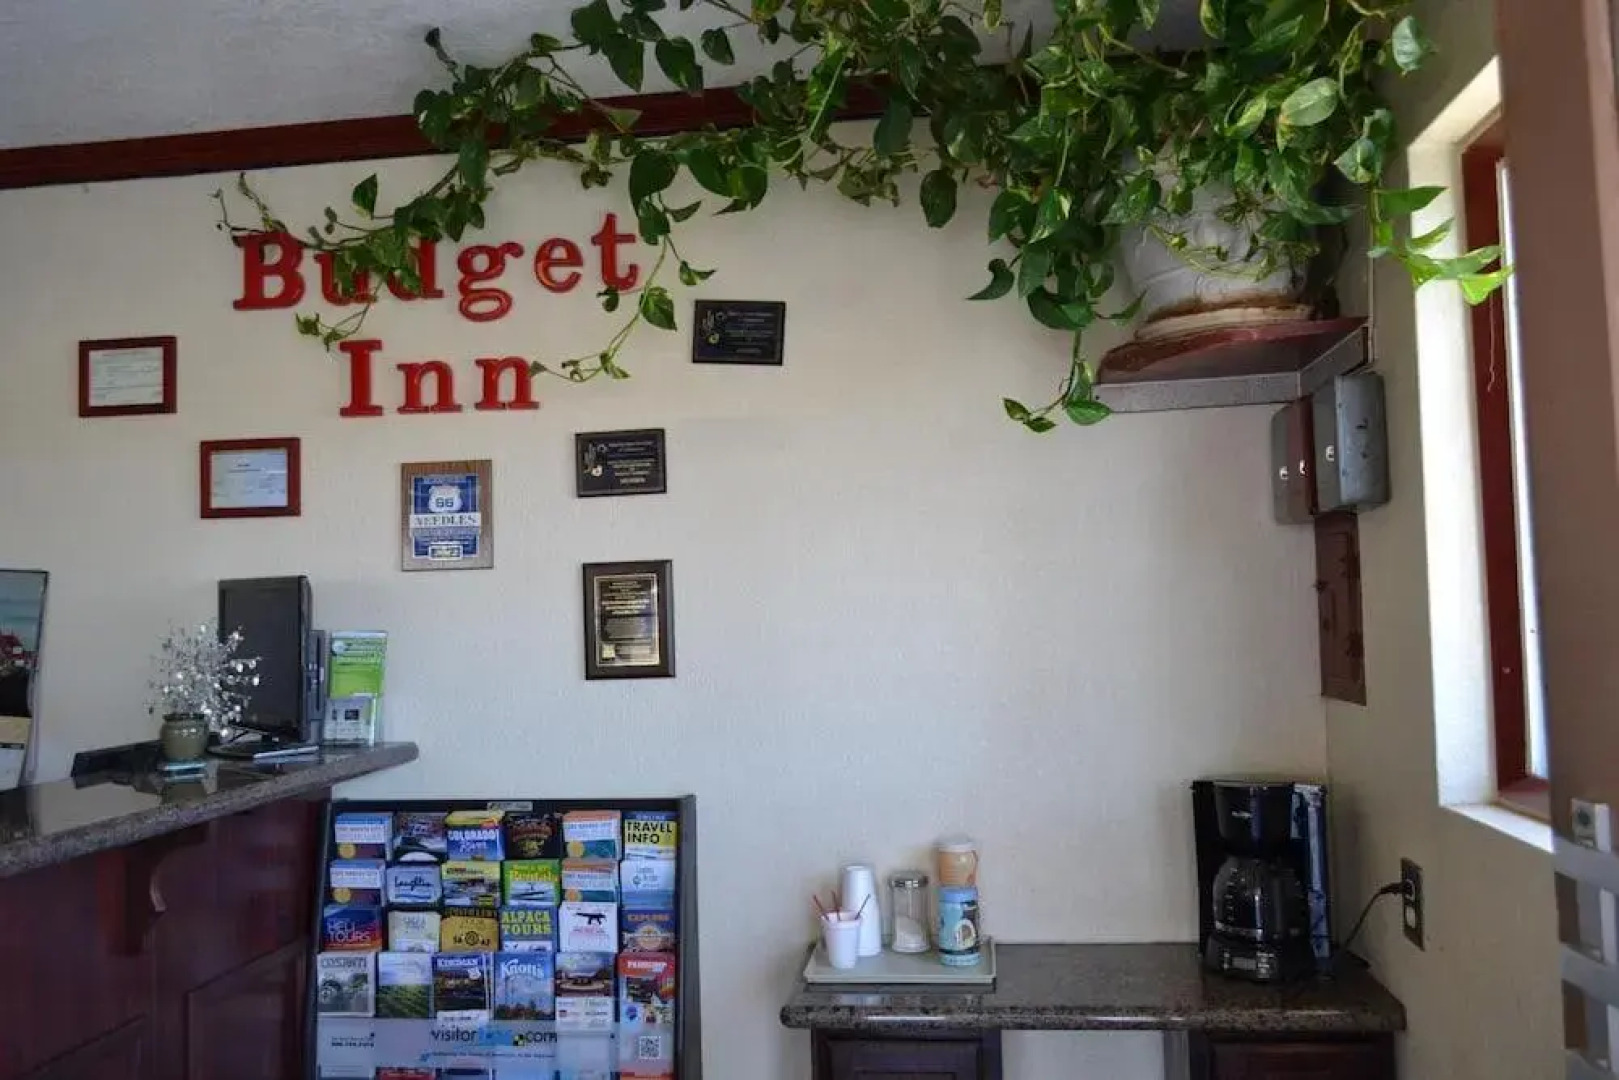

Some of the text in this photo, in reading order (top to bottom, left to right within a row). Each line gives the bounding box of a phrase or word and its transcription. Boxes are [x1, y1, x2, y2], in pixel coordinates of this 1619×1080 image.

[232, 212, 642, 322] Budget
[339, 339, 539, 416] Inn
[627, 821, 672, 833] TRAVEL
[627, 833, 660, 844] INFO
[502, 911, 550, 923] ALPACA
[502, 923, 552, 935] TOURS
